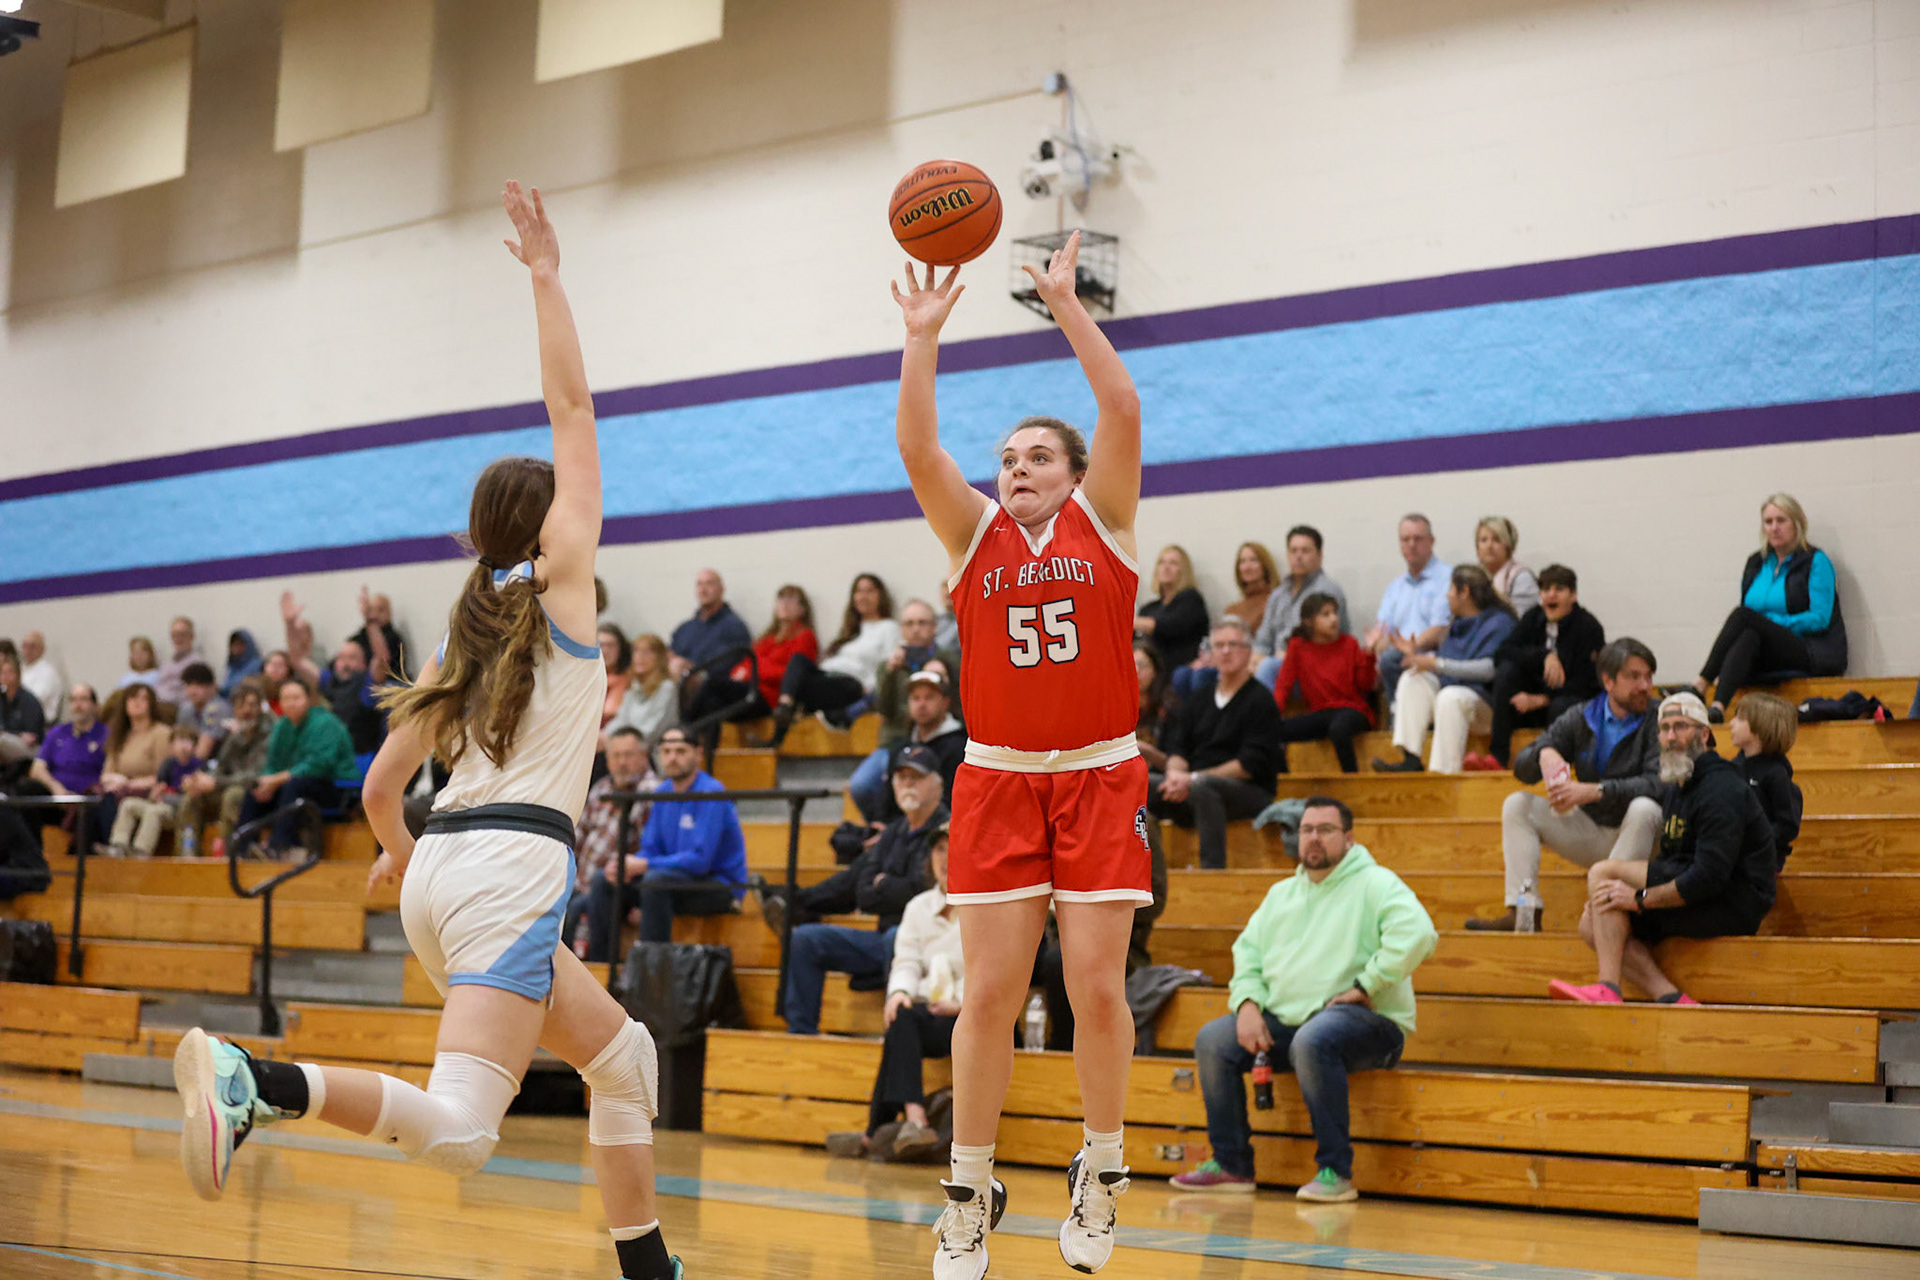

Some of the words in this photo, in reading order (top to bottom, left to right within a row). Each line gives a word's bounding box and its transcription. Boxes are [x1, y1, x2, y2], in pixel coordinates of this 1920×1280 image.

[899, 187, 975, 227] Wilson
[983, 566, 1010, 599] ST.
[1016, 556, 1095, 587] BENEDICT
[1007, 597, 1080, 668] 55
